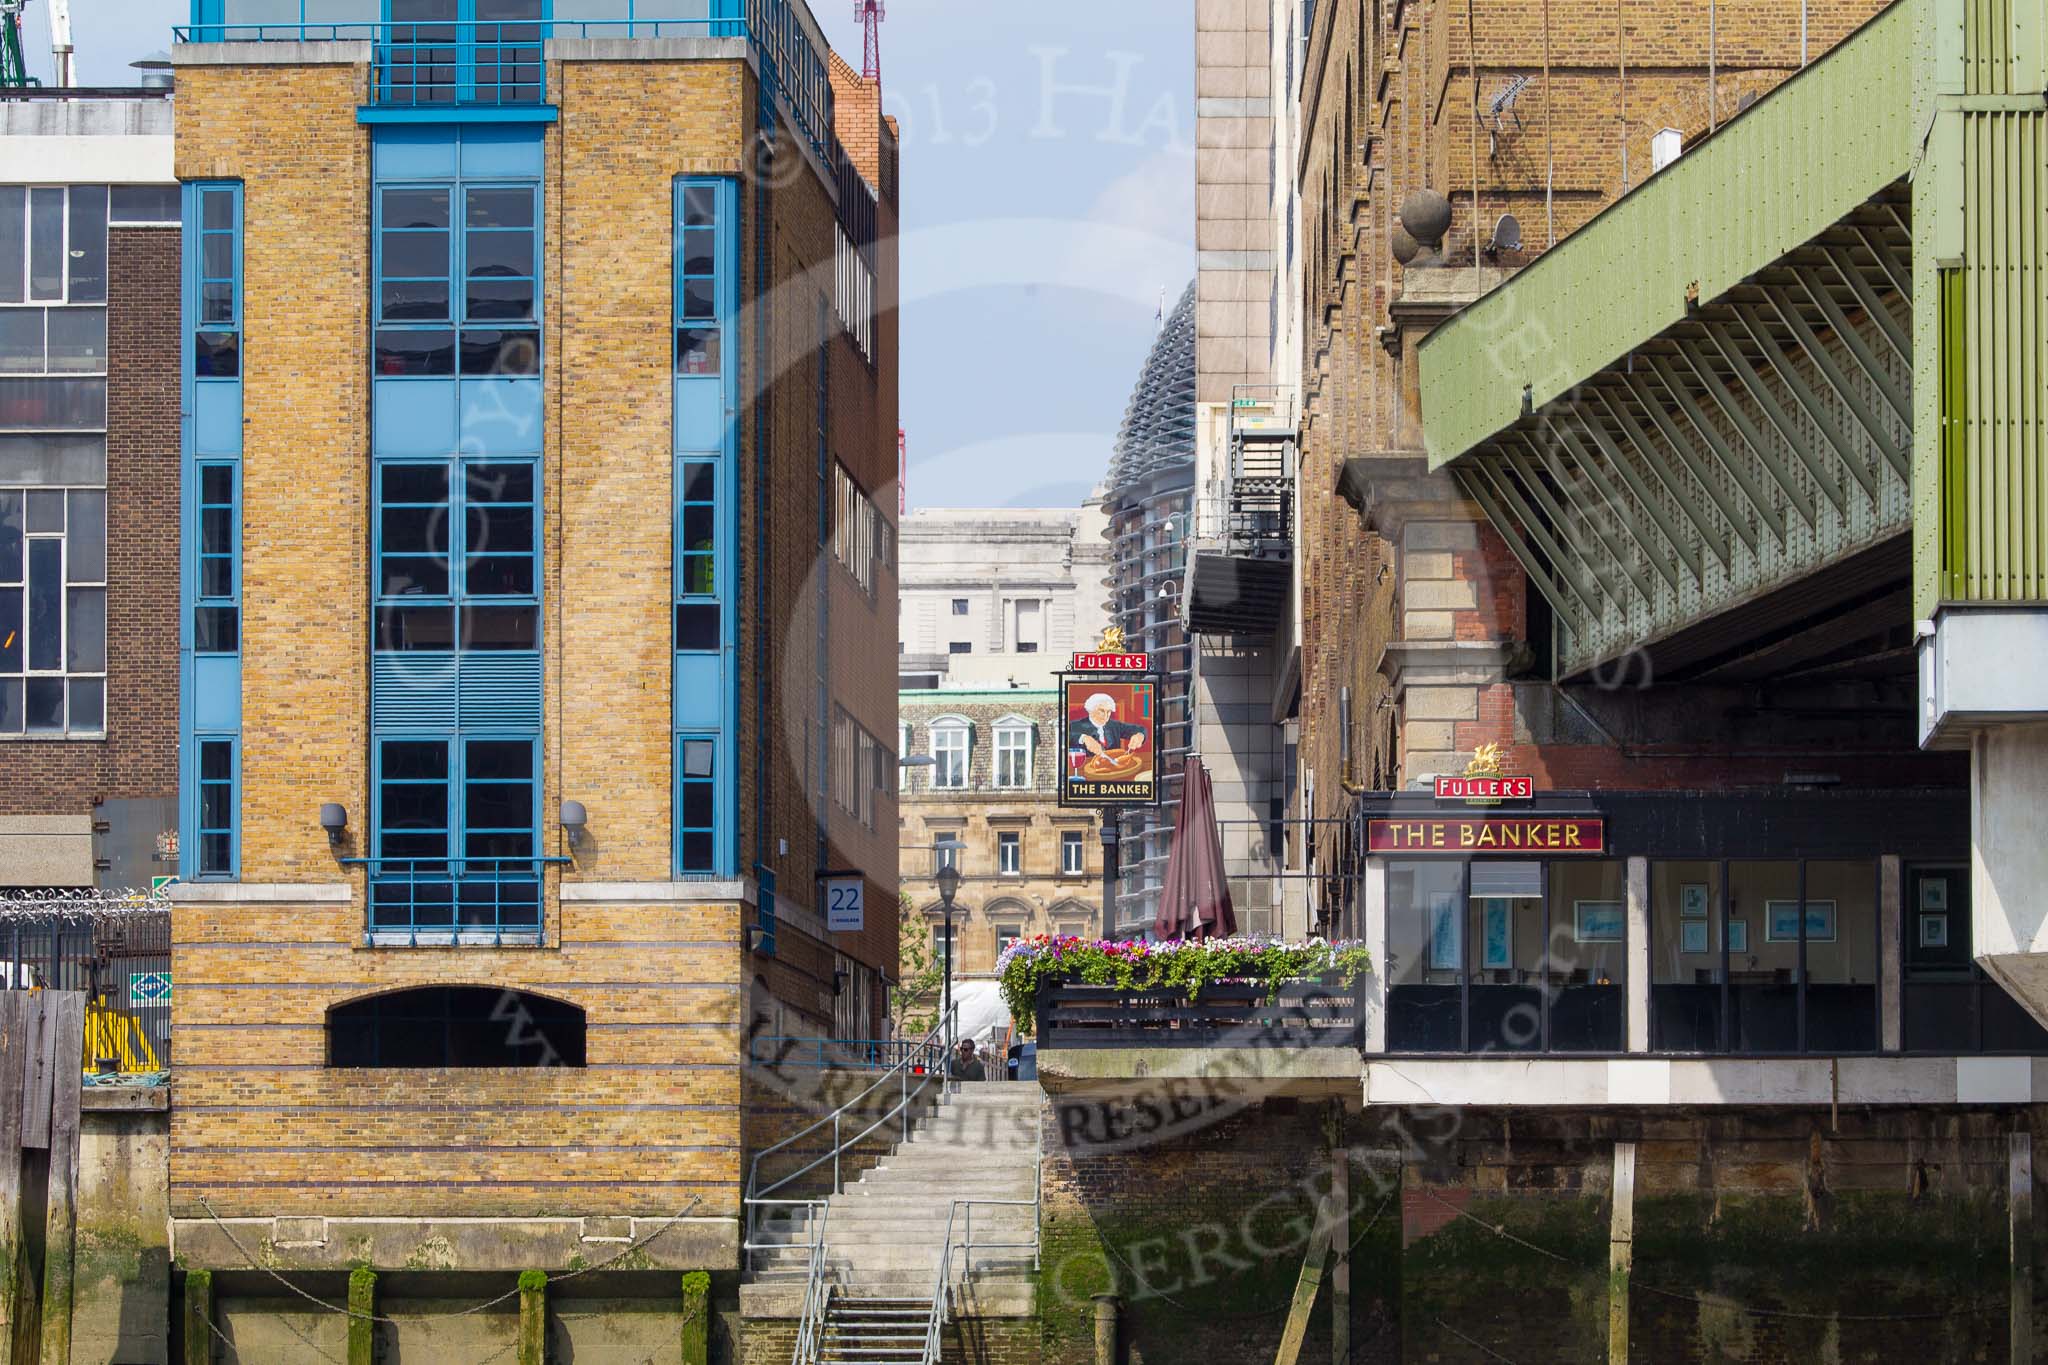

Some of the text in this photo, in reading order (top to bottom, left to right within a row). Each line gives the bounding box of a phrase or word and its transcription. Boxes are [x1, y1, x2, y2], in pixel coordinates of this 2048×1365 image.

[1078, 655, 1143, 669] FULLER'S
[1072, 784, 1149, 795] THE BANKER
[1440, 779, 1526, 797] FULLER'S
[1390, 824, 1582, 848] THE BANKER
[831, 888, 860, 911] 22
